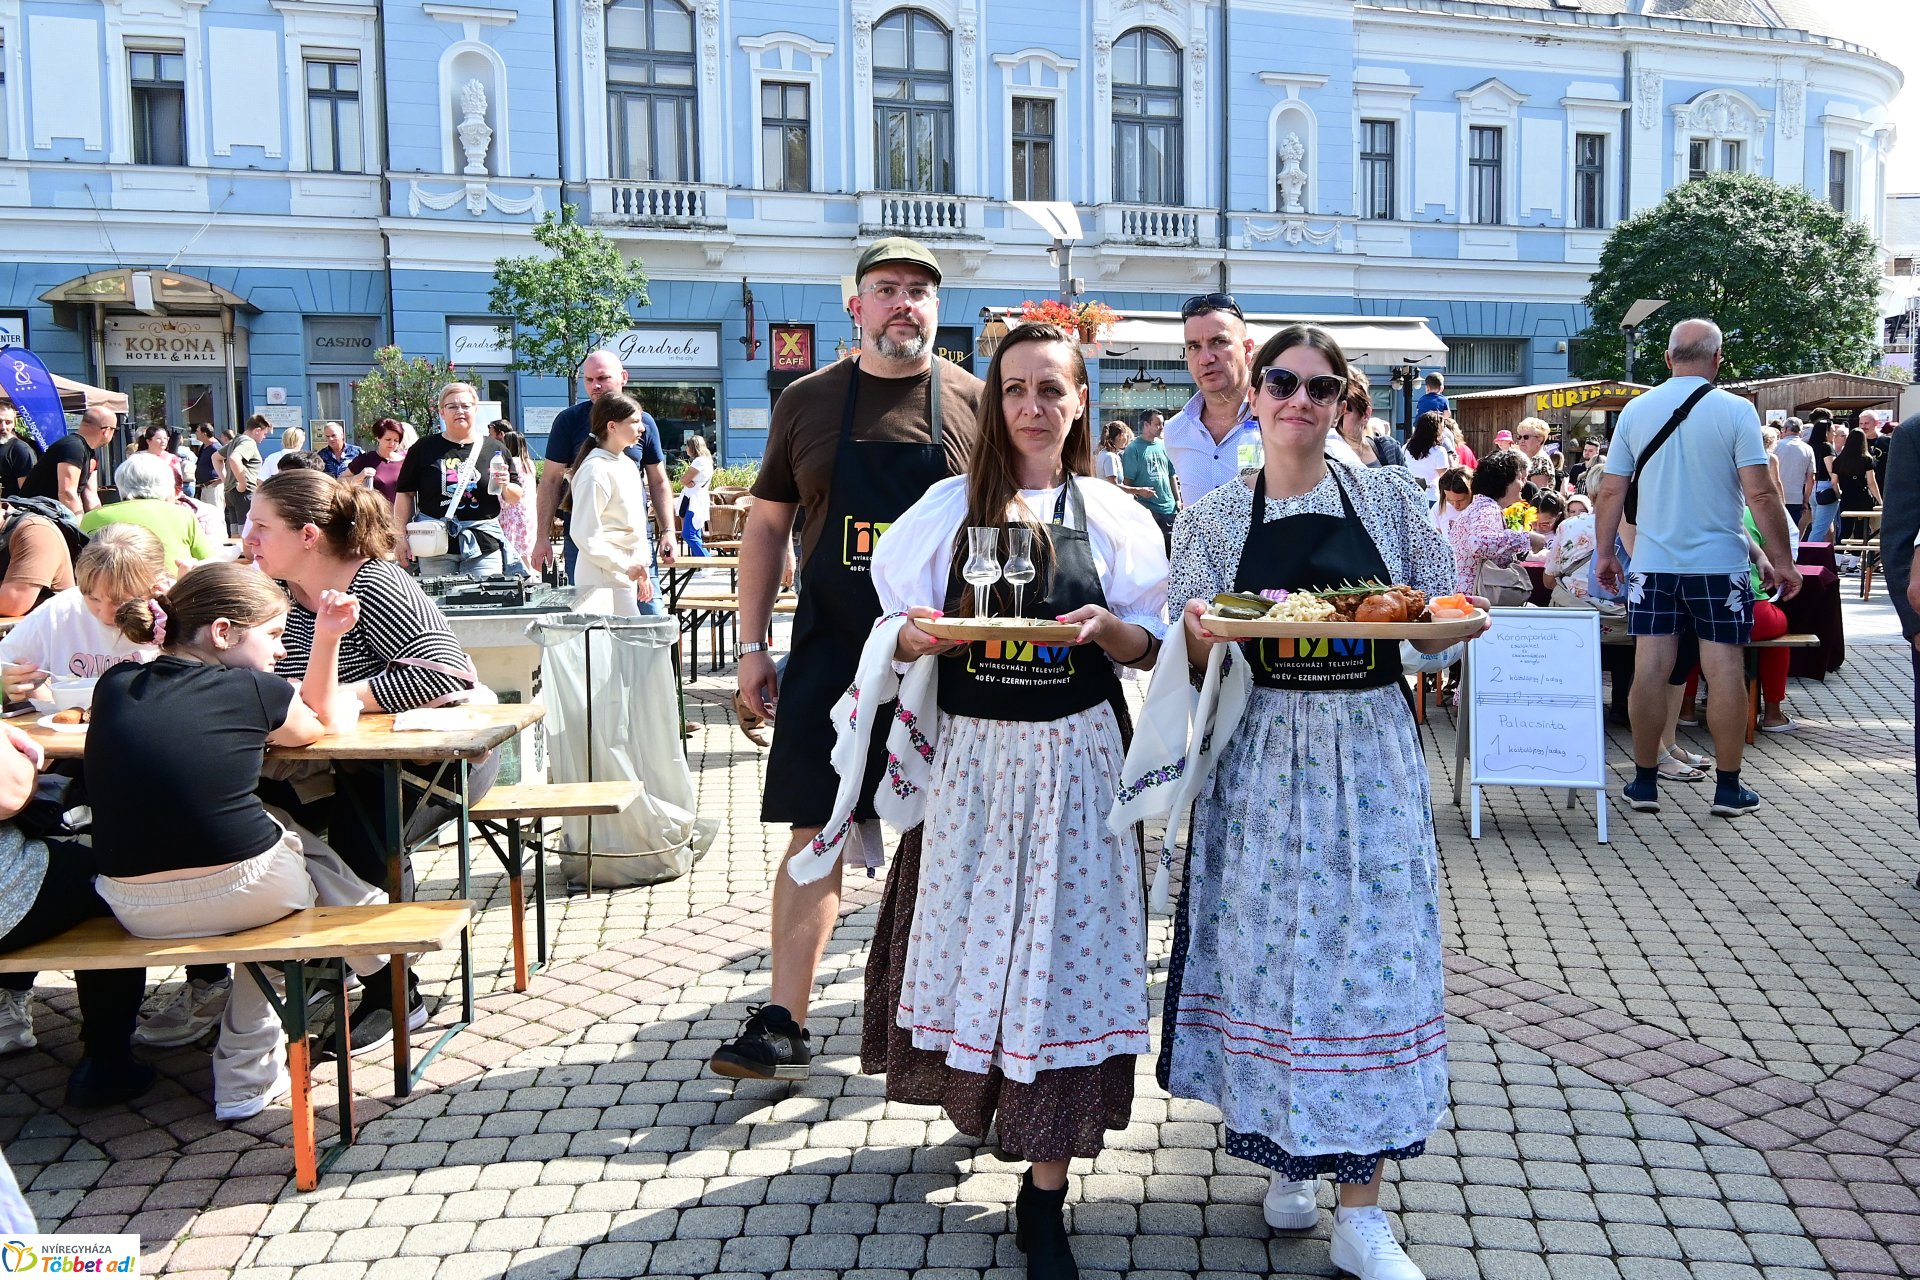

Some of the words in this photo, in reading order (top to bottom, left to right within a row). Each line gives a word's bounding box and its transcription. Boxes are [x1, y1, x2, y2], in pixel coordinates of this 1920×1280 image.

[0, 334, 21, 343] NTER
[125, 337, 216, 352] KORONA
[315, 336, 372, 348] CASINO
[779, 332, 803, 356] X
[618, 334, 700, 361] Gardrobe
[126, 352, 167, 360] HOTEL
[170, 352, 181, 362] &
[778, 356, 805, 366] CAFÉ
[979, 662, 1027, 672] NYÍREGYHÁZI
[1274, 660, 1323, 668] NYÍREGYHÁZI
[1328, 659, 1364, 668] TELEVÍZIÓ
[974, 674, 985, 682] 40
[985, 674, 996, 683] ÉV
[1001, 676, 1032, 686] EZERNYI
[1033, 676, 1071, 686] TÖRTÉNET
[1281, 672, 1292, 681] ÉV
[1331, 671, 1368, 681] TÖRTÉNET
[1490, 666, 1503, 683] 2
[1499, 714, 1568, 731] Palacsinta
[1490, 734, 1501, 755] 1
